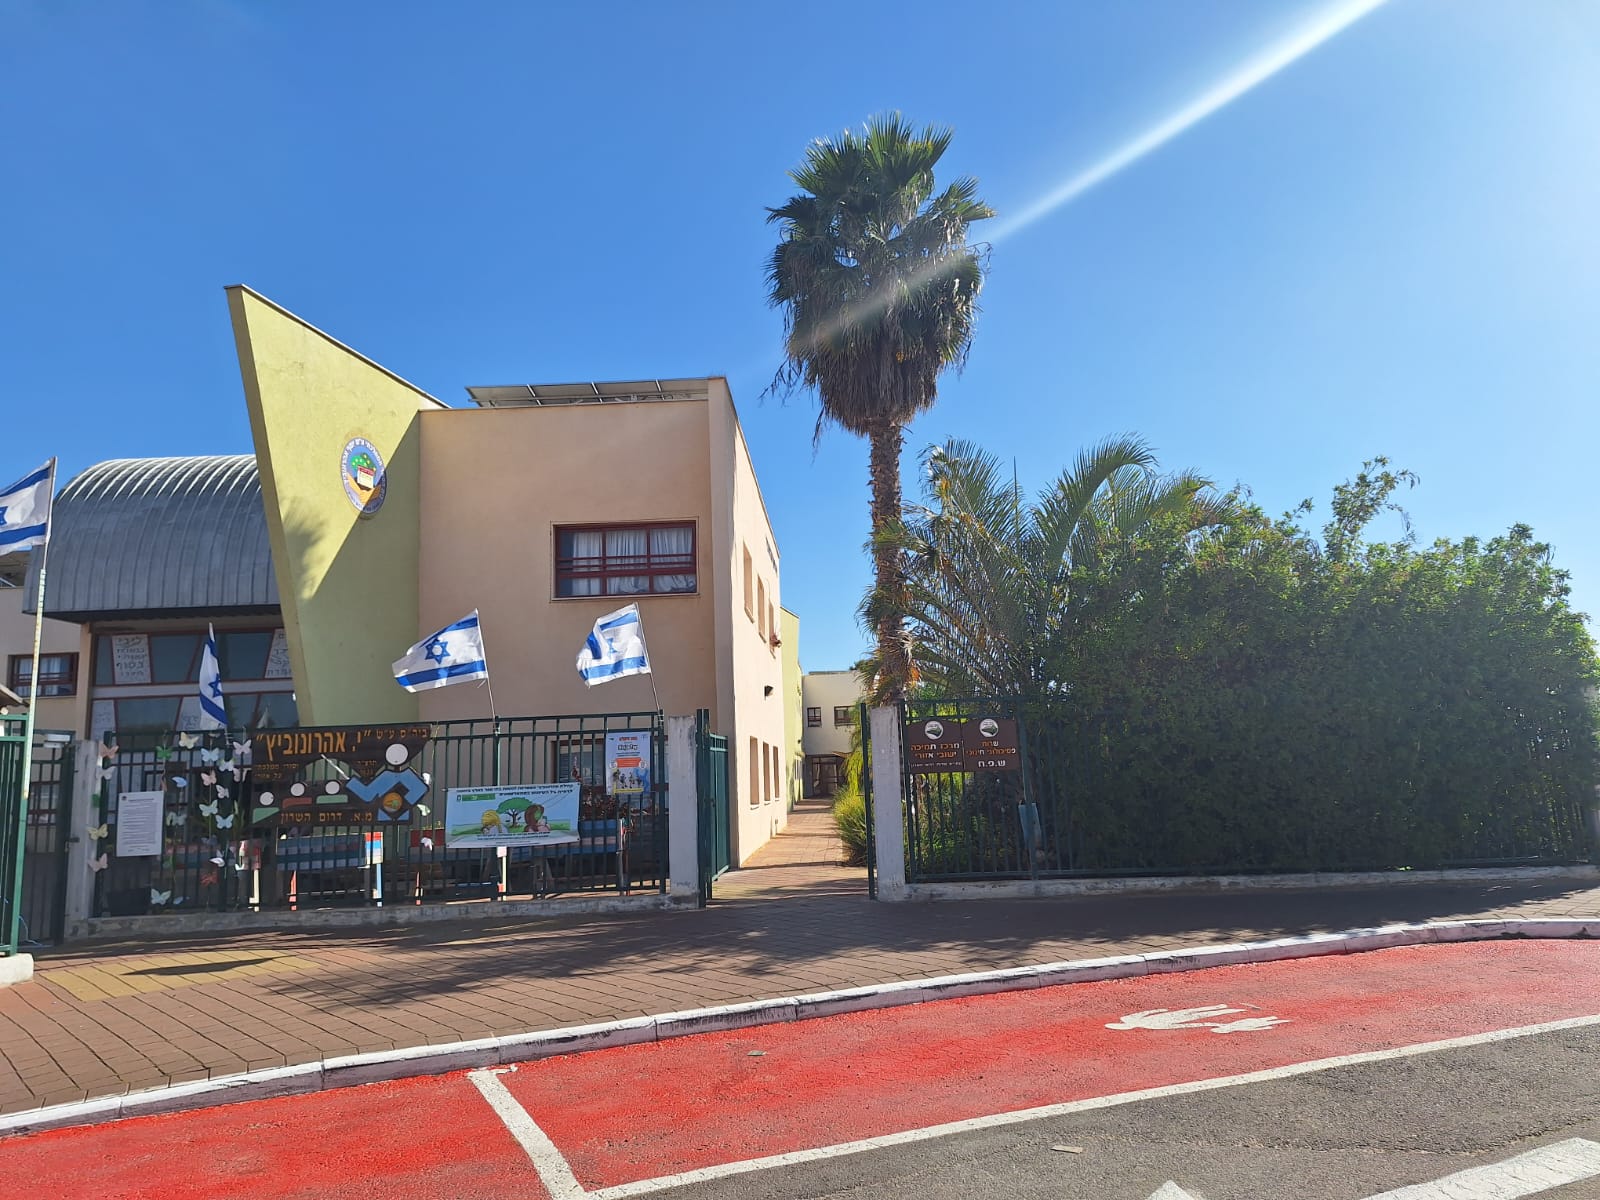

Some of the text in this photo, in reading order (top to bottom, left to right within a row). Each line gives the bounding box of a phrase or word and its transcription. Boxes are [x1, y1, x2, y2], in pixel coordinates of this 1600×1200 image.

[911, 743, 937, 751] תמיכה
[978, 760, 1006, 768] ש.פ.ח
[281, 812, 311, 824] השרון
[319, 812, 342, 822] דרום
